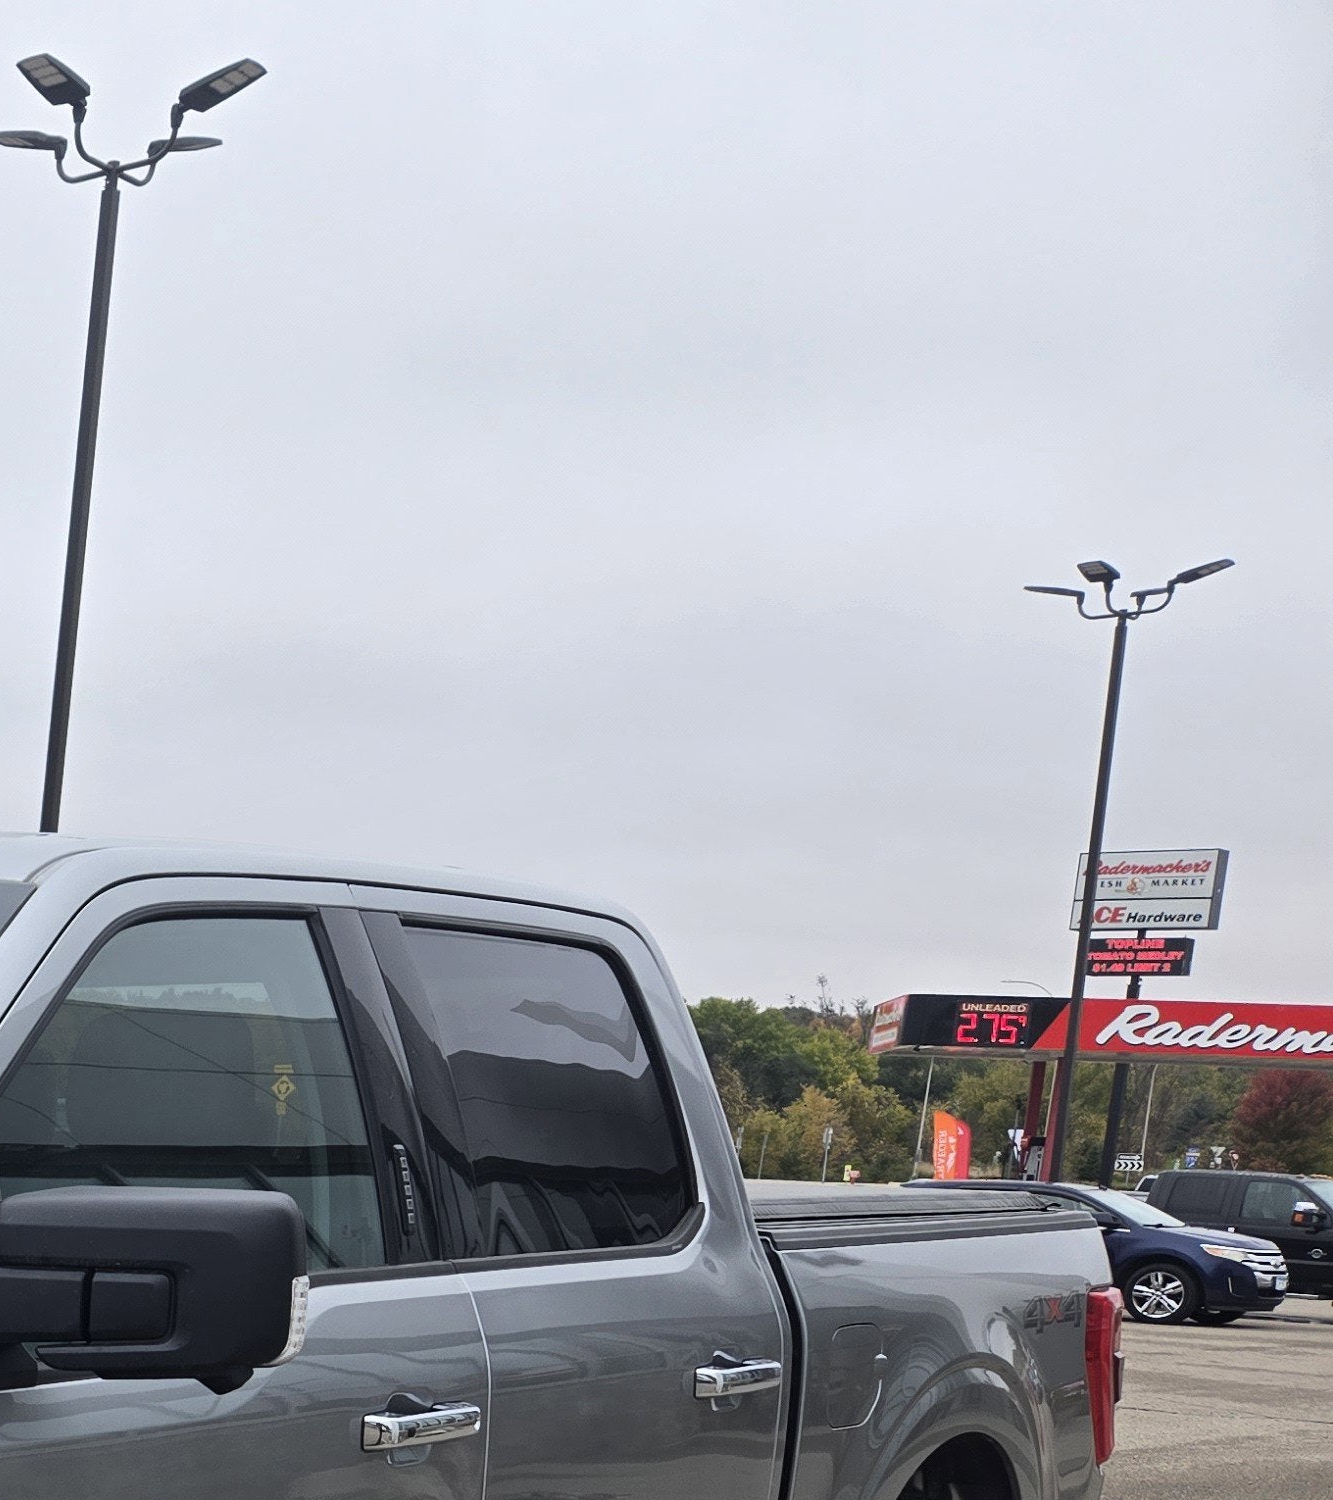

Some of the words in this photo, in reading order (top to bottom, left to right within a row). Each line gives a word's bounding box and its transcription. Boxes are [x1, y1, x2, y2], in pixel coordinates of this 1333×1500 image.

[1100, 880, 1122, 888] ESH
[1151, 878, 1206, 887] MARKET
[1078, 906, 1127, 924] CE
[1126, 911, 1202, 923] Hardware
[962, 1003, 1026, 1013] UNLEADED
